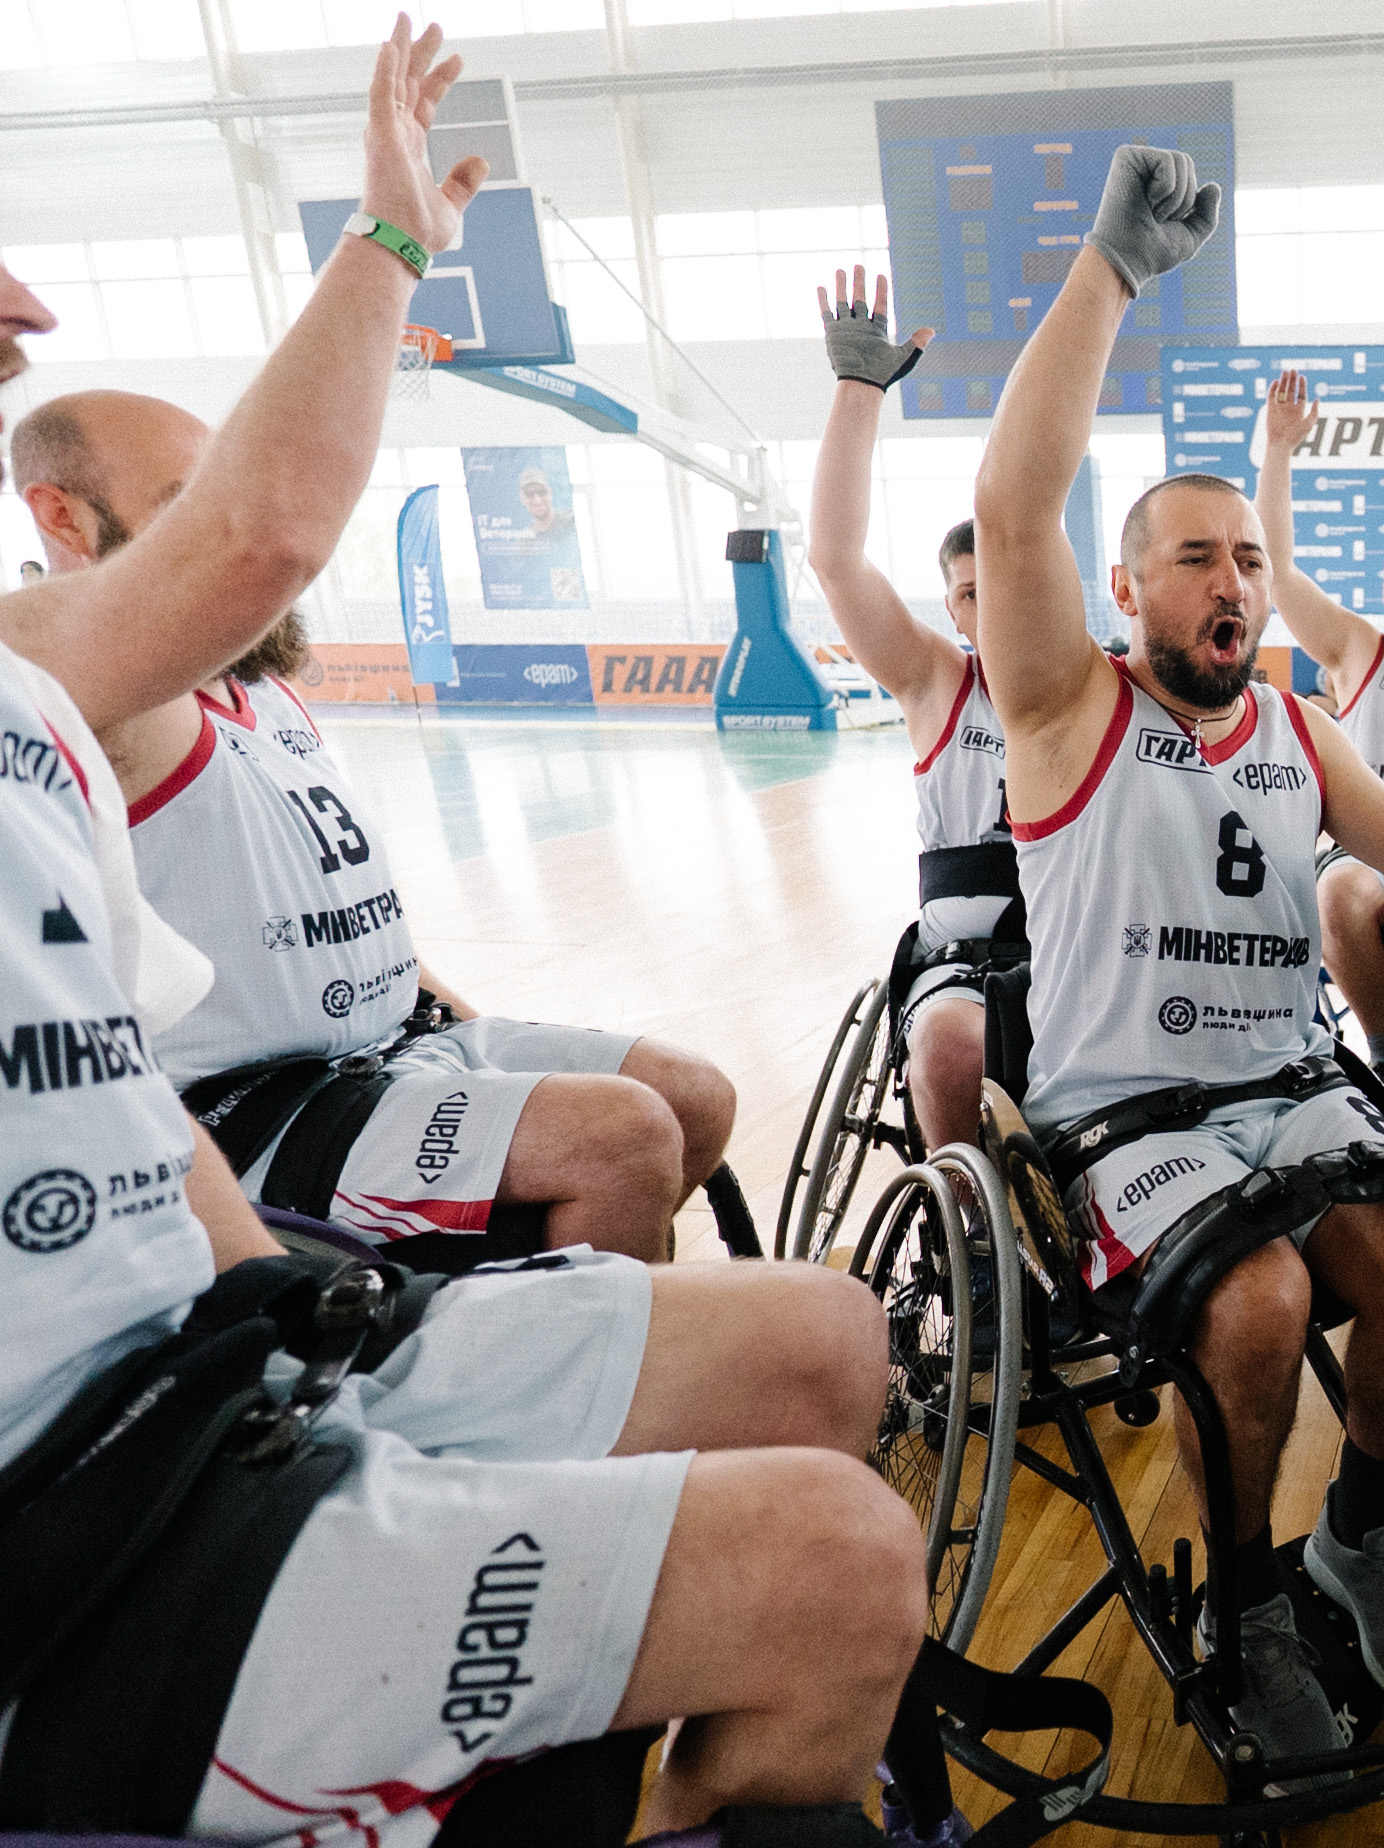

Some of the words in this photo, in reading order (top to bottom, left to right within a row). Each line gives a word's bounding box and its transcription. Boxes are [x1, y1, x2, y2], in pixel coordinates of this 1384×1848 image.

[413, 564, 435, 628] JYSK
[1144, 734, 1207, 767] ГАР
[287, 786, 370, 875] 13
[1216, 810, 1267, 897] 8
[1158, 926, 1310, 969] МІНВЕТЕРАВ
